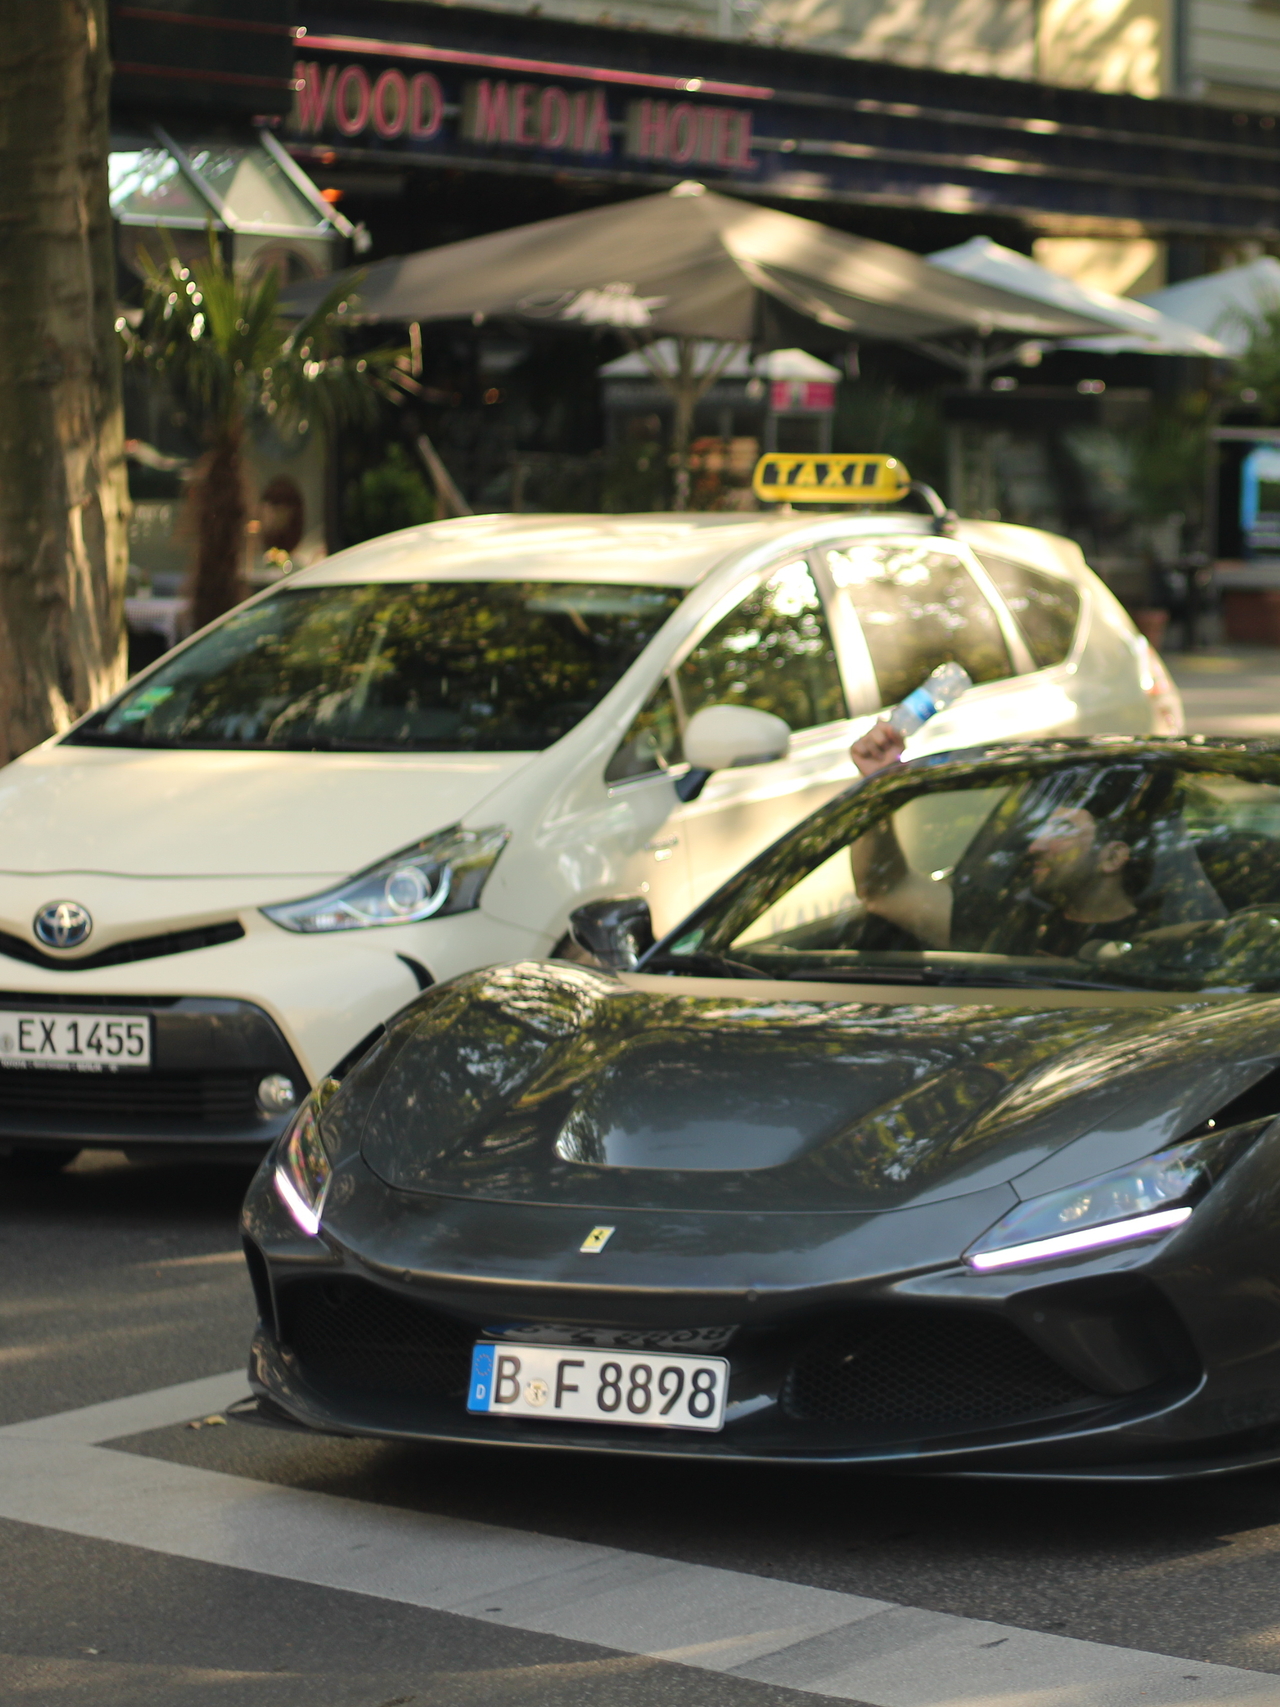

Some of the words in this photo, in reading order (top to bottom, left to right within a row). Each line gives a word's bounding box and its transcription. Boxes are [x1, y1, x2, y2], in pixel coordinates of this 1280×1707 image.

[295, 61, 441, 137] WOOD
[476, 78, 611, 154] MEDIA
[632, 100, 758, 170] HOTEL
[774, 460, 866, 486] TAXI
[18, 1018, 56, 1054] EX
[66, 1020, 144, 1056] 1455
[475, 1383, 486, 1400] D
[494, 1355, 521, 1404] B
[554, 1359, 585, 1408] F
[596, 1362, 718, 1419] 8898
